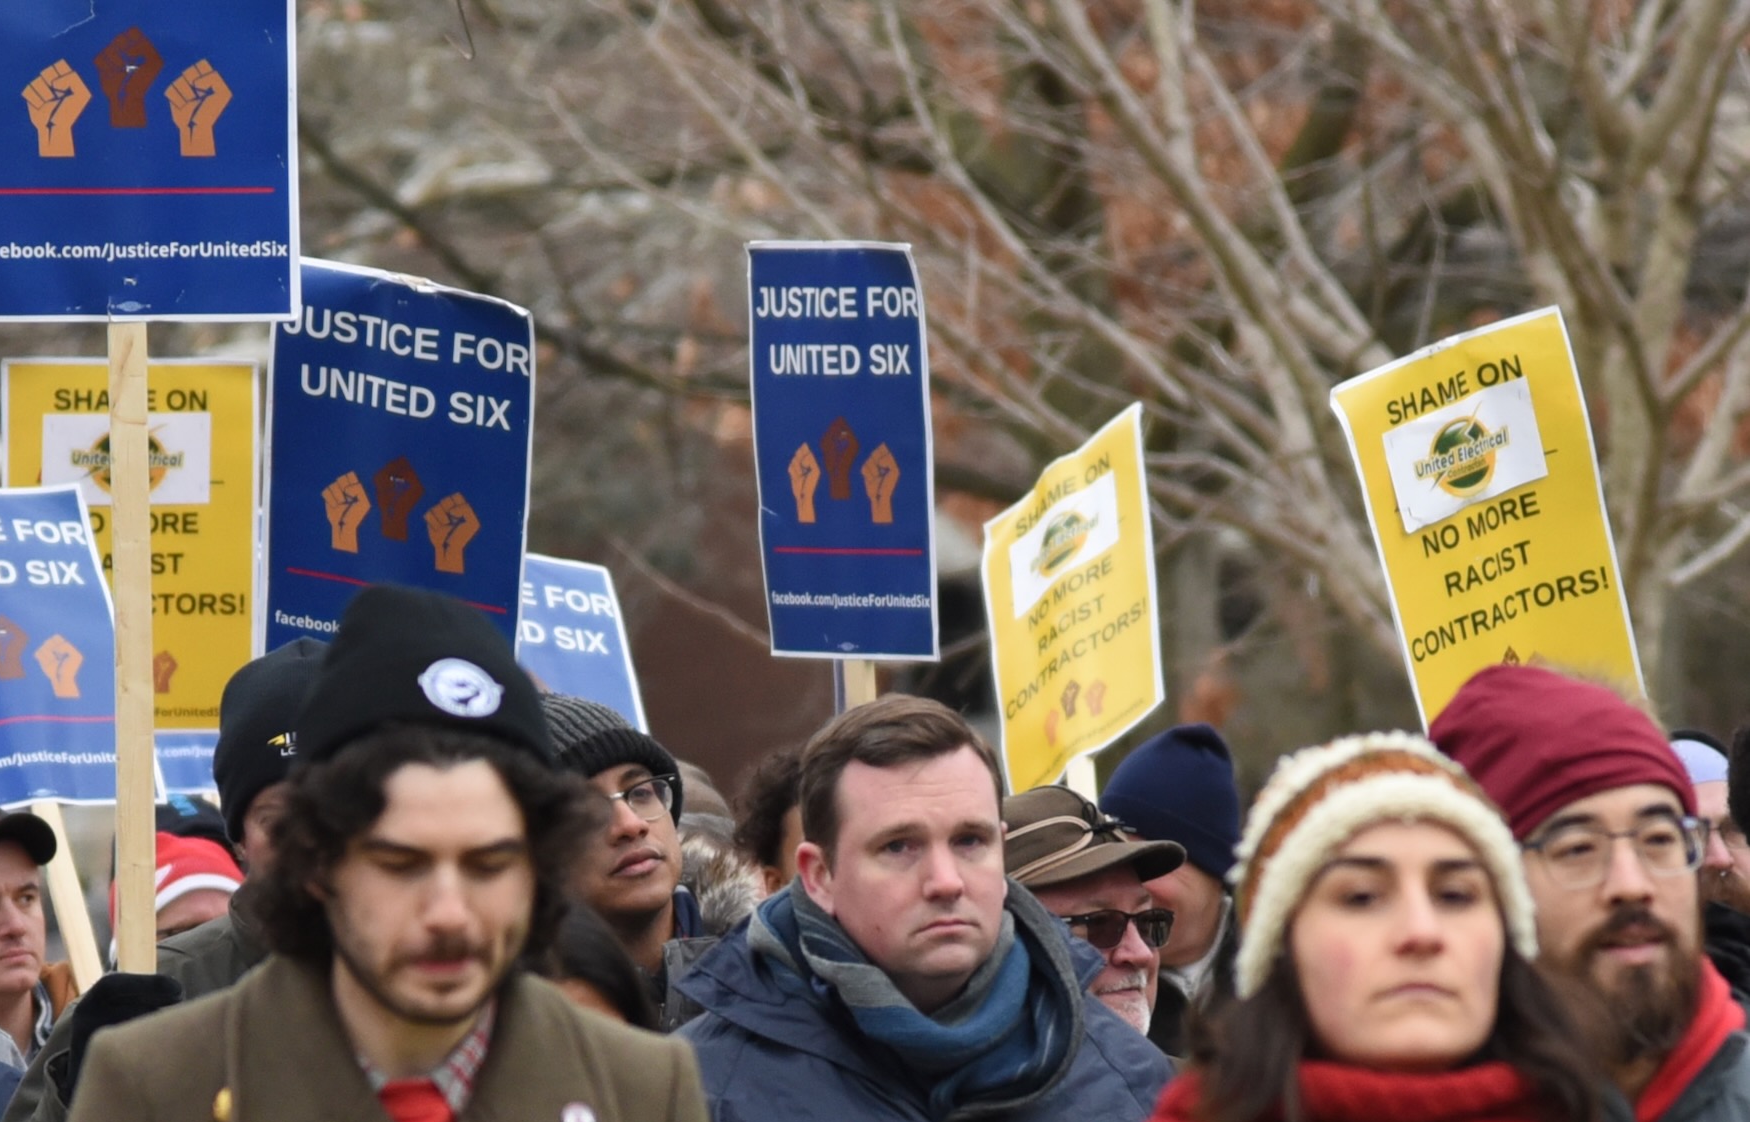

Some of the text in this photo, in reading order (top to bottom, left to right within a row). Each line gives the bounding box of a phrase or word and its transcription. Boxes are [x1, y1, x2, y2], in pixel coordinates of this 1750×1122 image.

[756, 286, 919, 318] JUSTICE FOR
[282, 305, 530, 377] JUSTICE FOR
[770, 344, 911, 375] UNITED SIX
[53, 388, 208, 411] SHAE ON
[300, 364, 511, 431] UNITED SIX
[1386, 354, 1523, 426] SHAME ON
[1415, 428, 1507, 478] United Electrical
[1015, 452, 1111, 538] SHAME ON
[12, 518, 88, 546] FOR
[1422, 492, 1540, 558] NO MORE
[25, 560, 85, 586] SIX
[1027, 555, 1114, 633] NO MORE
[1444, 541, 1531, 598] RACIST
[544, 585, 614, 618] FOR
[771, 590, 931, 610] facebook.com/JusticeForUnitedSix
[1037, 594, 1105, 657] RACIST
[1412, 566, 1609, 662] CONTRACTORS!
[553, 625, 609, 655] SIX
[1005, 597, 1147, 721] CONTRACTORS!
